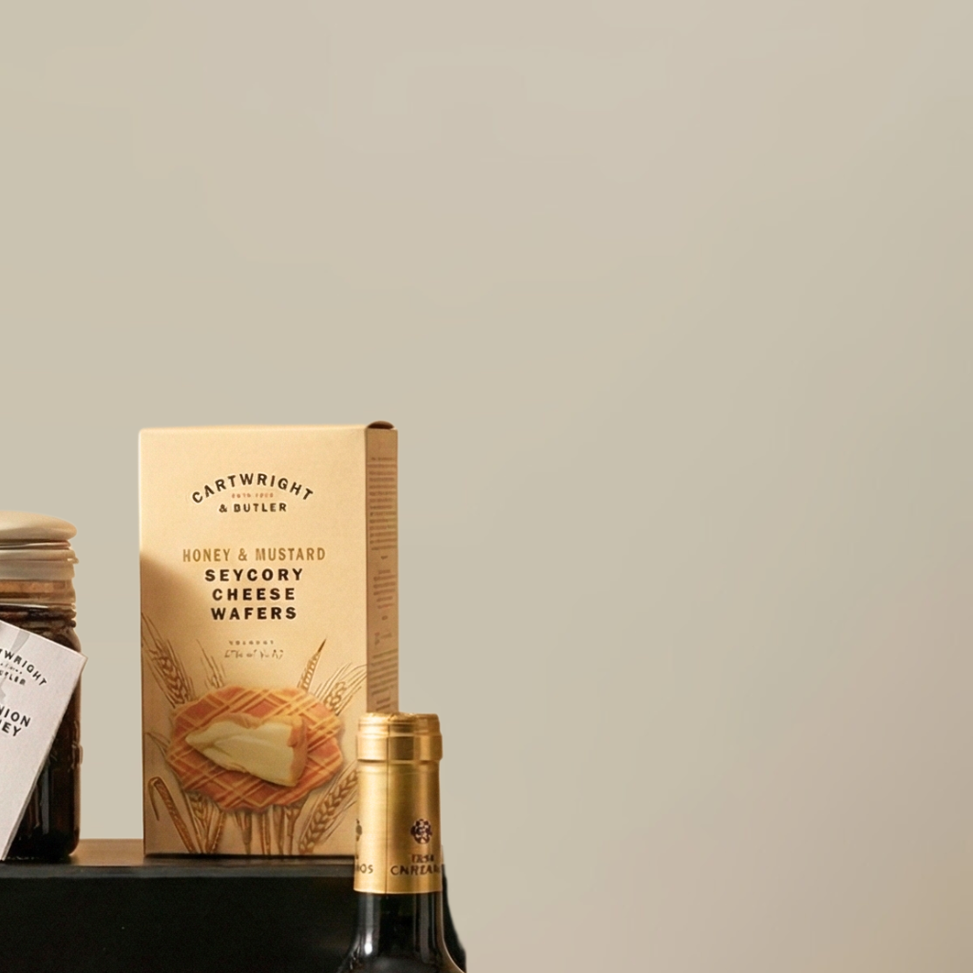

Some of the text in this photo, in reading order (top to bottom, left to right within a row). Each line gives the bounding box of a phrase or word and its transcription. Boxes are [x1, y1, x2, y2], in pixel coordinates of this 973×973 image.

[191, 472, 314, 504] CARTWRIGHT
[218, 503, 228, 513] &
[182, 547, 326, 563] HONEY & MUSTARD
[204, 567, 303, 582] SEYCORY
[211, 587, 295, 601] CHEESE
[210, 606, 297, 620] WAFERS
